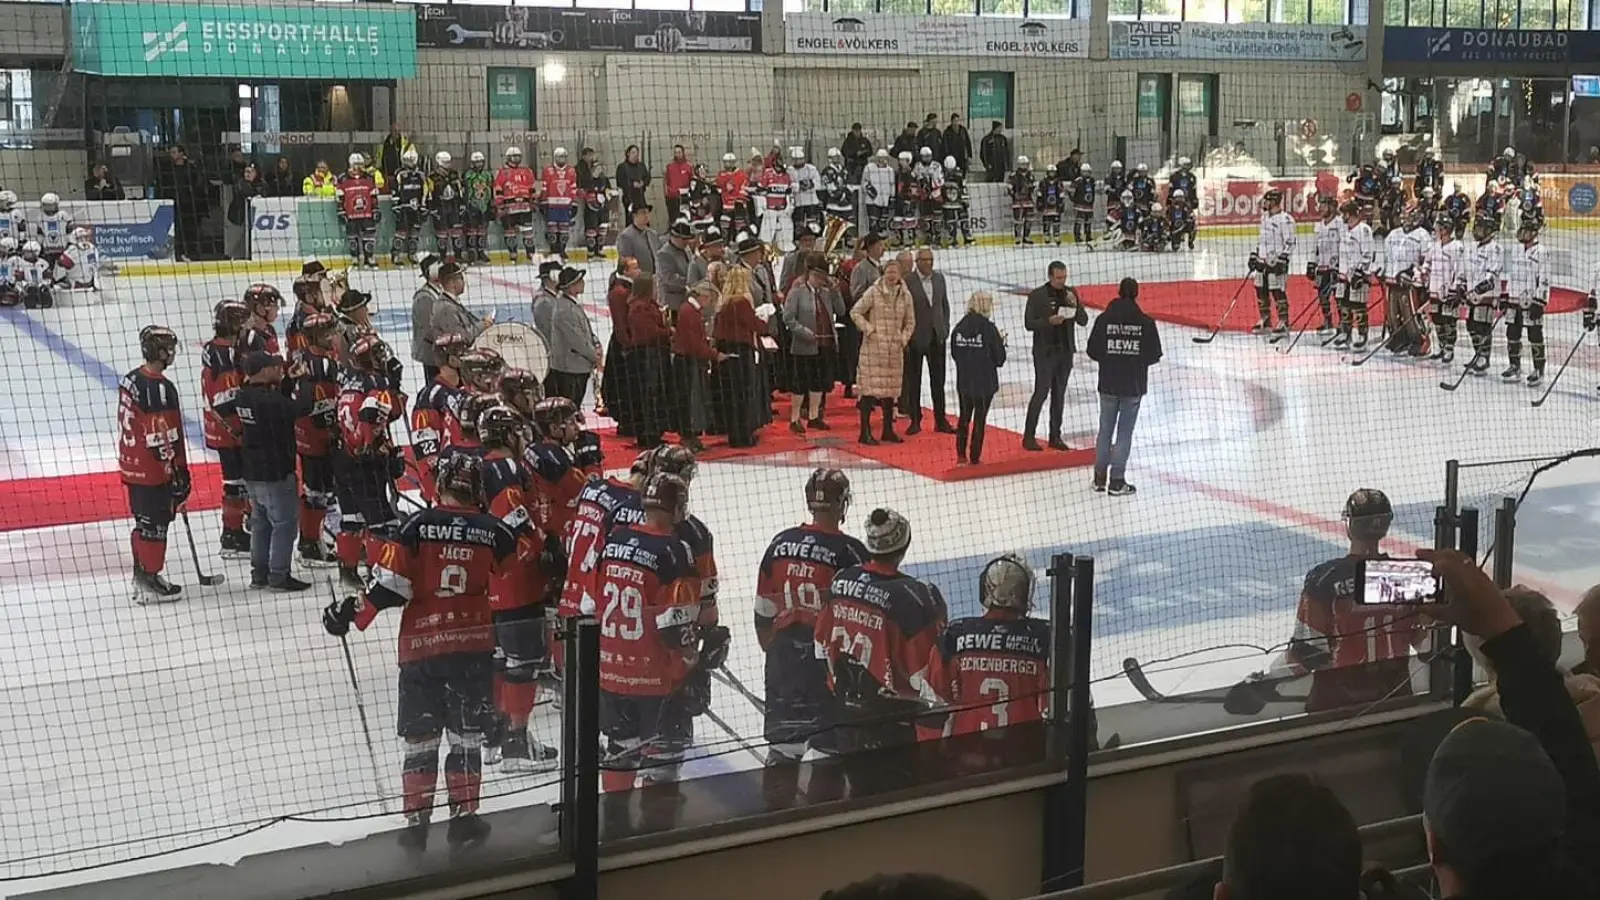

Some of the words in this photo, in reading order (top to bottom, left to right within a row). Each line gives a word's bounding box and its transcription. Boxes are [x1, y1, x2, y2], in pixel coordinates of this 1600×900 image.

[202, 21, 379, 42] EISSPORTHALLE
[1127, 21, 1182, 34] TAILOR
[797, 37, 899, 49] ENGEL&VÖLKERS
[1129, 34, 1176, 47] STEEL
[1463, 32, 1568, 47] DONAUBAD
[1107, 339, 1140, 351] REWE
[421, 440, 437, 455] 22
[419, 525, 463, 541] REWE
[601, 582, 644, 640] 29
[956, 634, 1003, 651] REWE
[1363, 614, 1394, 662] 11
